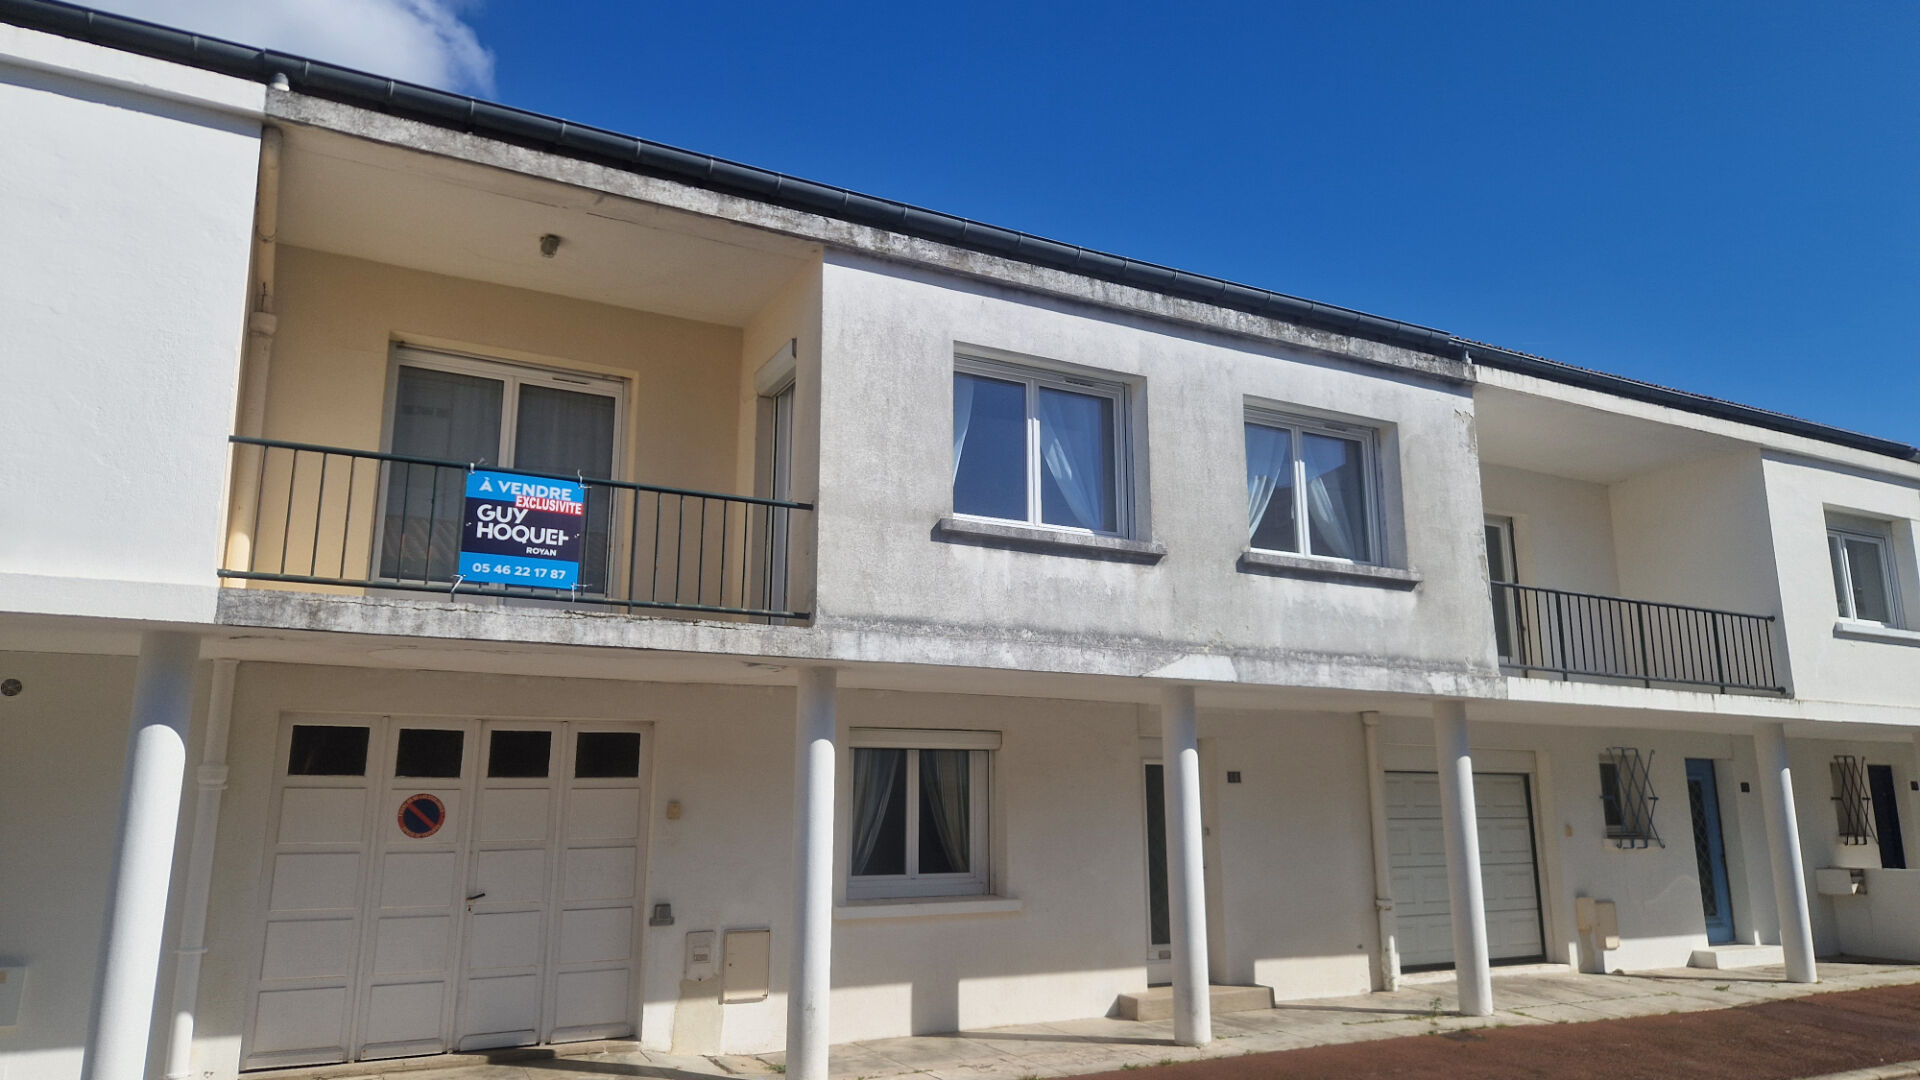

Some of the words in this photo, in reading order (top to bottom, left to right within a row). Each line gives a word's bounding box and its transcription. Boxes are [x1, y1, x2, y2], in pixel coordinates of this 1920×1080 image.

[479, 476, 493, 493] À
[498, 480, 572, 501] VENDRE
[477, 504, 529, 524] GUY
[515, 496, 583, 515] EXCLUSIVITE
[476, 522, 569, 546] HOQUET
[526, 547, 557, 557] ROYAN
[472, 563, 490, 573] 05
[494, 565, 511, 575] 46
[514, 566, 530, 576] 22
[534, 568, 547, 578] 17
[550, 569, 566, 580] 87
